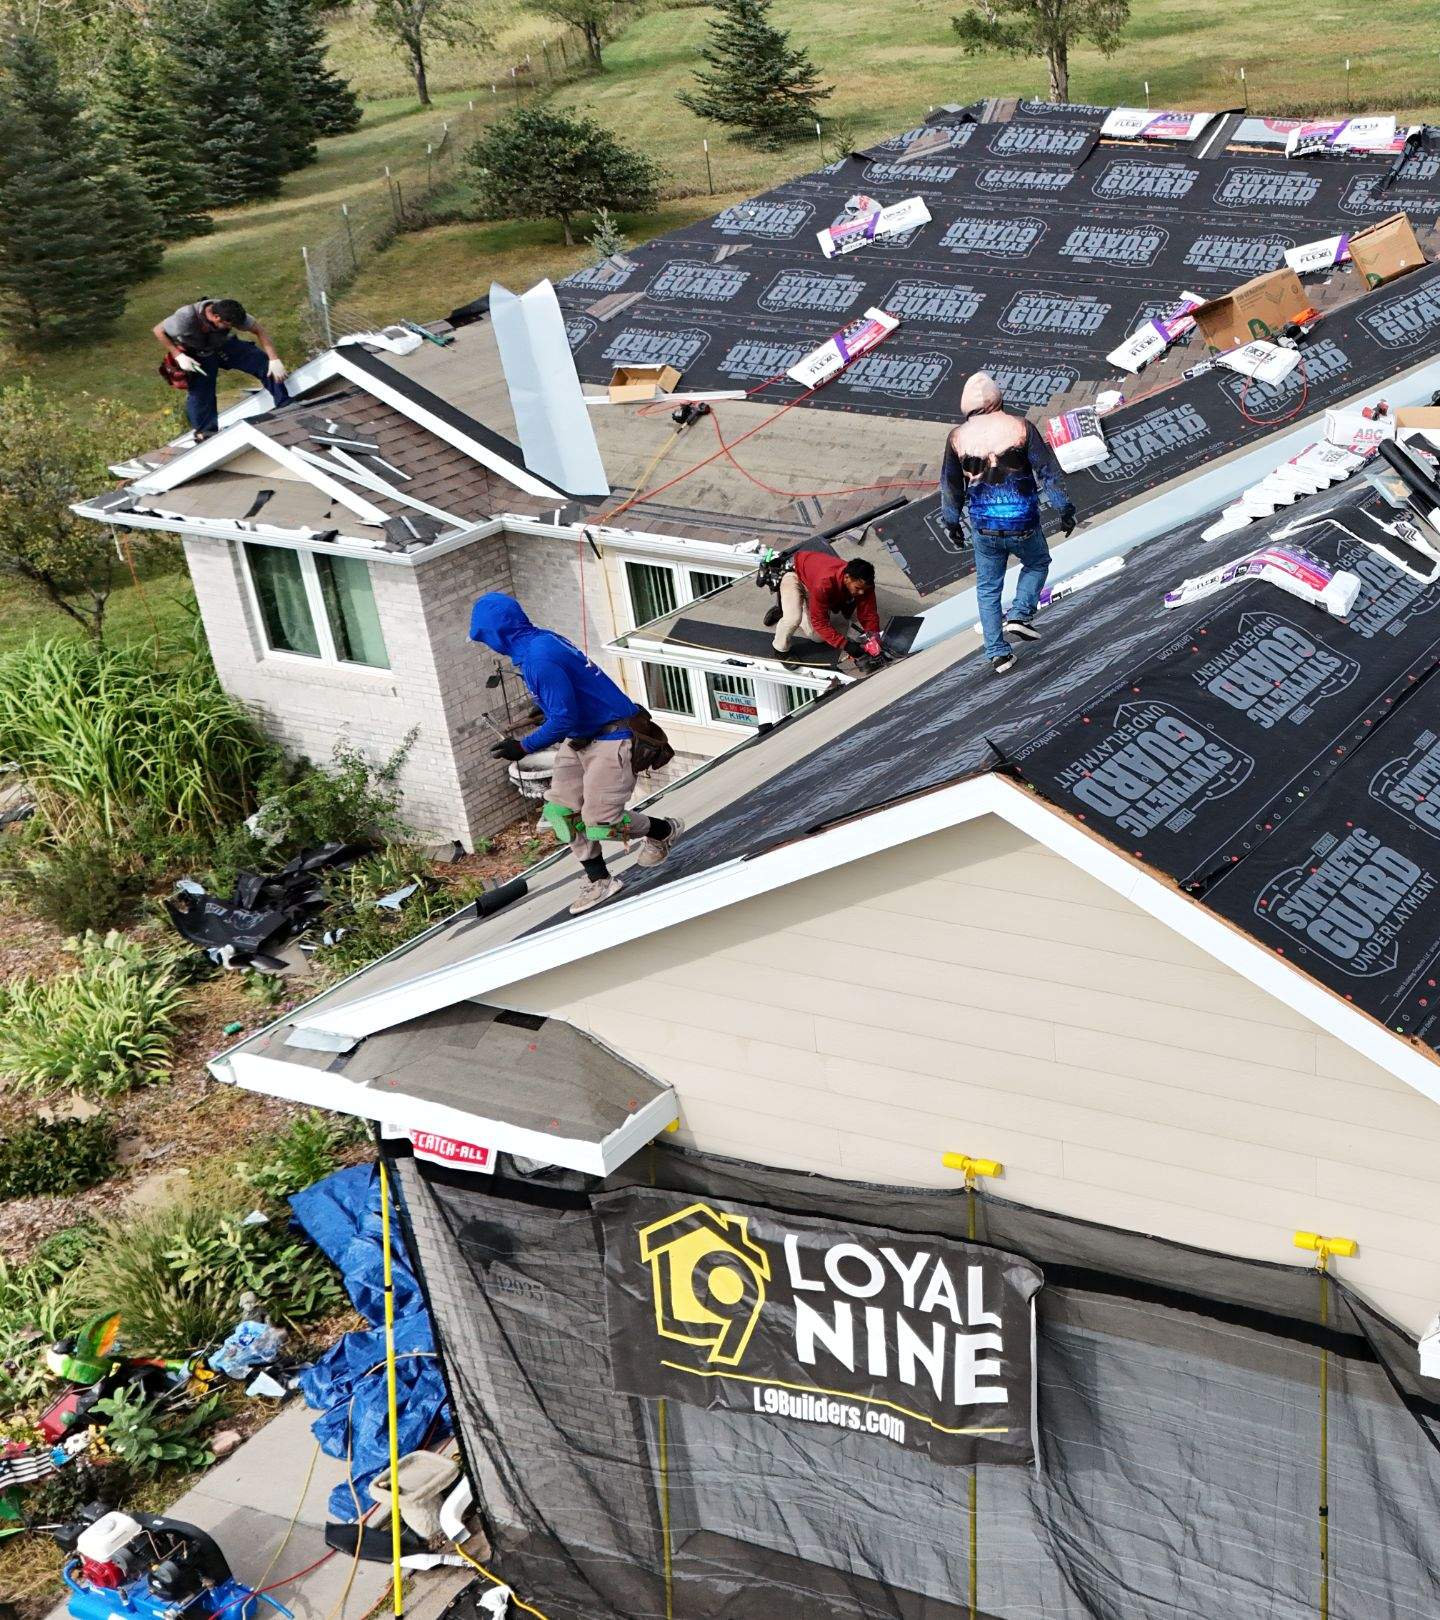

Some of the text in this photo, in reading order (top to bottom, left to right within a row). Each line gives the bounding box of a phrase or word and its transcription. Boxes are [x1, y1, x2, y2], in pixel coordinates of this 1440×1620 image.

[998, 133, 1087, 151] GUARD
[984, 170, 1074, 185] GUARD
[1112, 165, 1199, 181] SYNTHETIC
[1230, 173, 1322, 188] SYNTHETIC
[1097, 188, 1186, 199] UNDERLAYMENT
[1101, 176, 1193, 194] GUARD
[1222, 185, 1316, 201] GUARD
[1217, 191, 1310, 208] UNDERLAYMENT
[957, 216, 1042, 228] UNDERLAYMENT
[1075, 225, 1164, 237] UNDERLAYMENT
[947, 222, 1038, 243] GUARD
[1066, 231, 1160, 251] GUARD
[1199, 234, 1290, 247] UNDERLAYMENT
[939, 237, 1029, 252] SYNTHETIC
[1059, 246, 1152, 261] SYNTHETIC
[1189, 240, 1286, 261] GUARD
[1183, 255, 1278, 272] SYNTHETIC
[667, 265, 751, 282] SYNTHETIC
[652, 276, 743, 297] GUARD
[775, 274, 867, 292] SYNTHETIC
[649, 290, 732, 303] UNDERLAYMENT
[765, 283, 859, 308] GUARD
[897, 286, 986, 302] SYNTHETIC
[762, 299, 850, 314] UNDERLAYMENT
[885, 298, 980, 319] GUARD
[1017, 297, 1112, 314] SYNTHETIC
[1008, 308, 1104, 330] GUARD
[623, 326, 707, 341] UNDERLAYMENT
[1003, 322, 1096, 337] UNDERLAYMENT
[611, 335, 701, 357] GUARD
[866, 352, 947, 365] UNDERLAYMEN
[846, 357, 942, 381] GUARD
[980, 364, 1075, 378] UNDERLAYMENT
[839, 374, 933, 392] SYNTHETIC
[1328, 374, 1367, 394] tamko.com
[1109, 403, 1196, 448] NTHETIC
[1353, 428, 1383, 439] ABC
[1105, 427, 1211, 480] UNDERLAYMENT
[1185, 441, 1223, 460] tamko.com
[1157, 636, 1194, 660] tamko.com
[1191, 616, 1280, 686] UNDERLAYMENT
[1206, 626, 1316, 710] GUARD
[1246, 650, 1342, 729] SYNTHETIC
[729, 713, 751, 722] KIRK
[1054, 704, 1166, 789] UNDERLAYMENT
[1072, 716, 1206, 817] GUARD
[1116, 743, 1234, 837] SYNTHETIC
[1276, 827, 1381, 930] SYNTHETIC
[1306, 846, 1421, 959] GUARD
[1351, 871, 1439, 972] UNDERLAYMENT
[418, 1134, 483, 1160] CATCH-ALL
[783, 1233, 1002, 1329] LOYAL
[792, 1294, 1009, 1406] NINE
[753, 1386, 906, 1445] L9Builders.com
